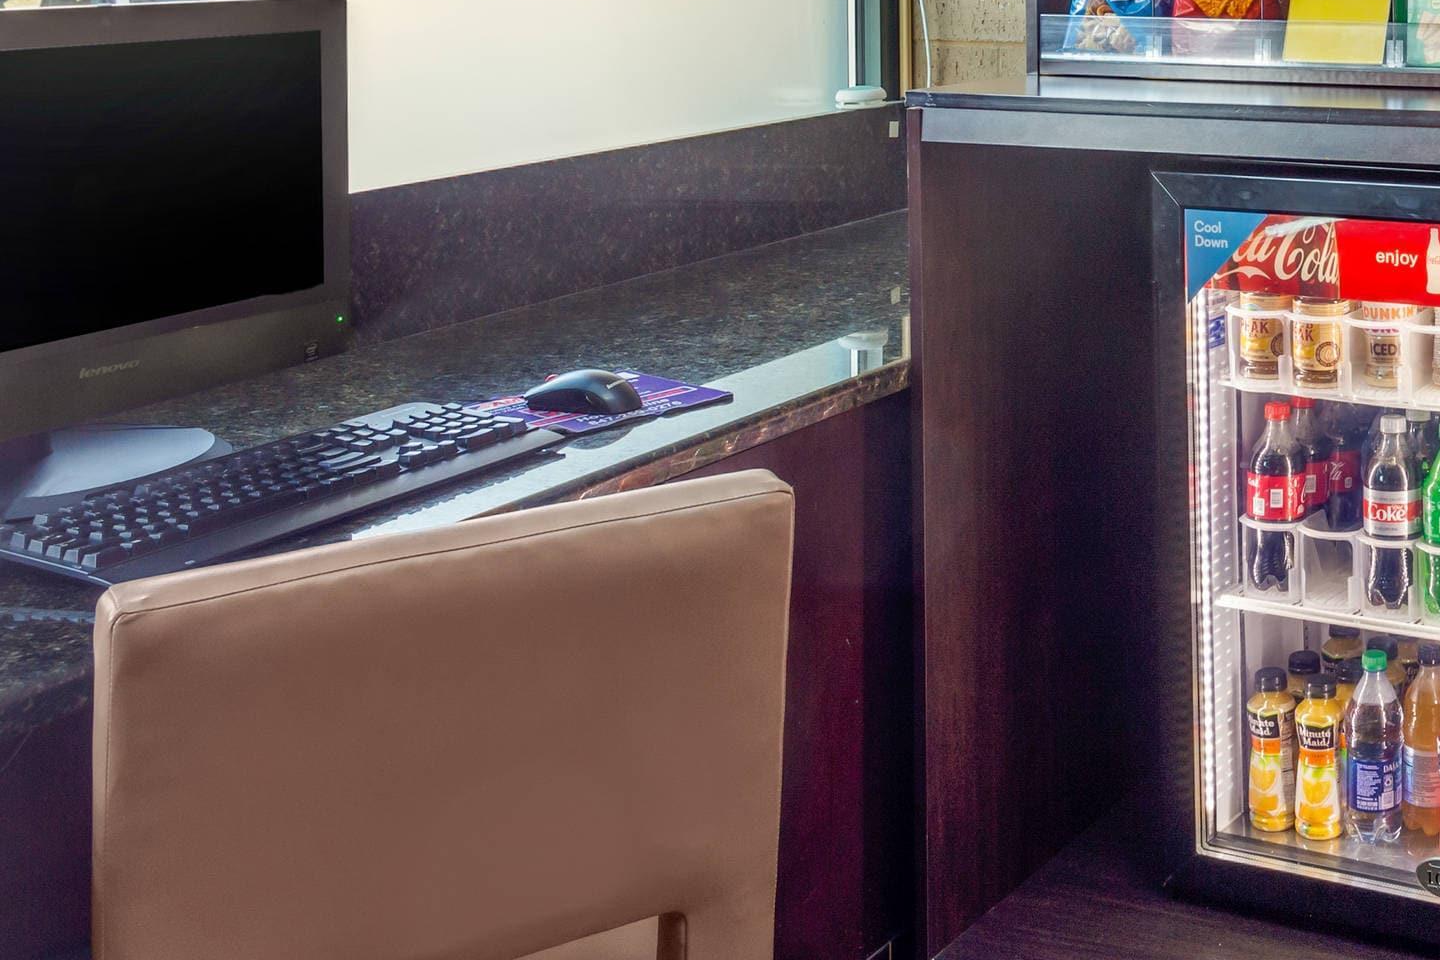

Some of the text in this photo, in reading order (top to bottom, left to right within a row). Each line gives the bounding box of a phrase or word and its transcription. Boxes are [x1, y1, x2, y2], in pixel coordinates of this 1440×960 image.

[1194, 220, 1222, 234] Cool
[1194, 234, 1229, 249] Down
[1375, 249, 1419, 270] enjoy
[79, 359, 140, 379] lenovo
[1368, 502, 1407, 522] Coke
